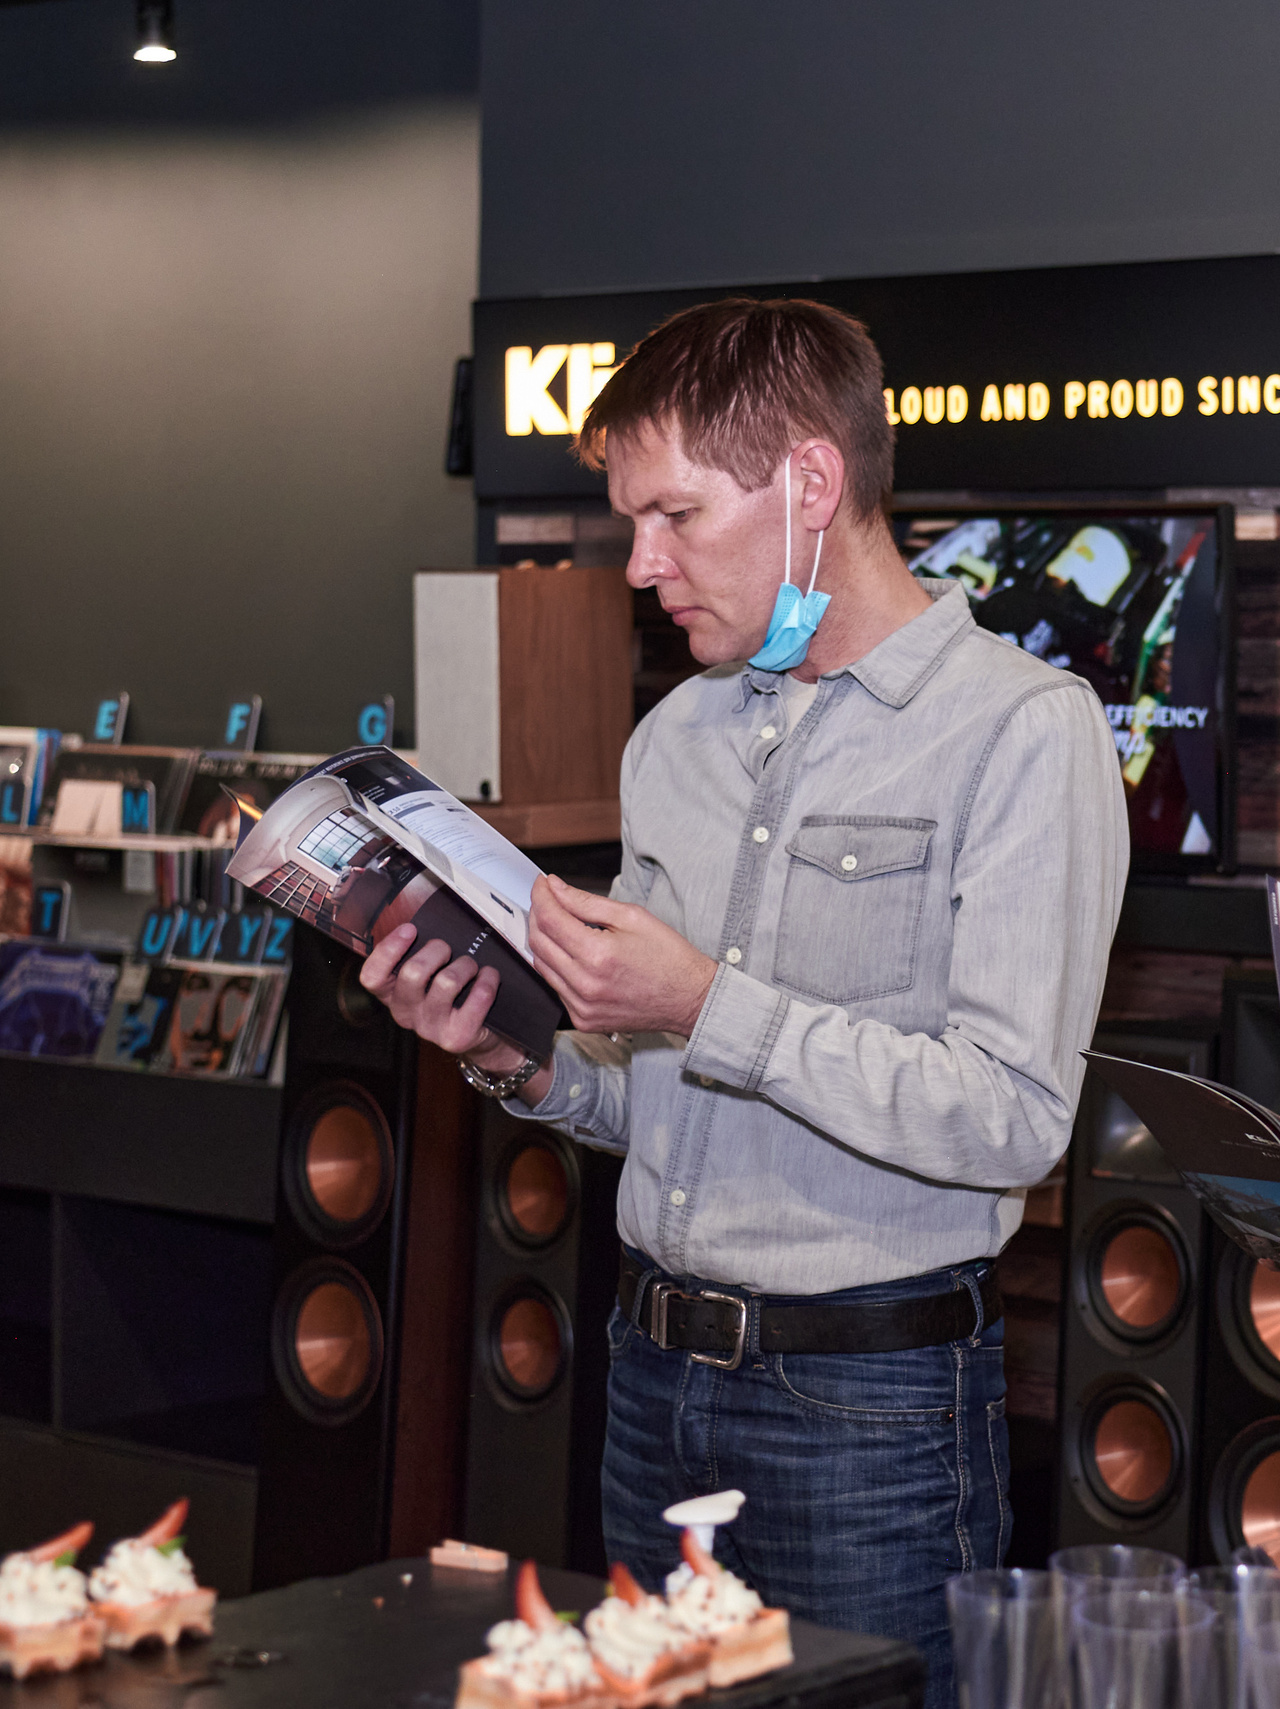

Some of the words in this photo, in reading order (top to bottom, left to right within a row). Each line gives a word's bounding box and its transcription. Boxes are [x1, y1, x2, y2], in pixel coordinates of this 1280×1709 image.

[505, 342, 622, 436] Kli
[883, 385, 968, 425] LOUD
[980, 382, 1050, 422] AND
[1064, 378, 1184, 419] PROUD
[94, 700, 119, 739] E
[226, 703, 250, 744] F
[358, 704, 387, 745] G
[3, 785, 19, 823] L
[124, 790, 149, 830] M
[41, 892, 60, 931] T
[142, 912, 173, 955] U
[238, 914, 262, 957] Y
[264, 917, 293, 958] Z
[467, 931, 489, 955] КАТА
